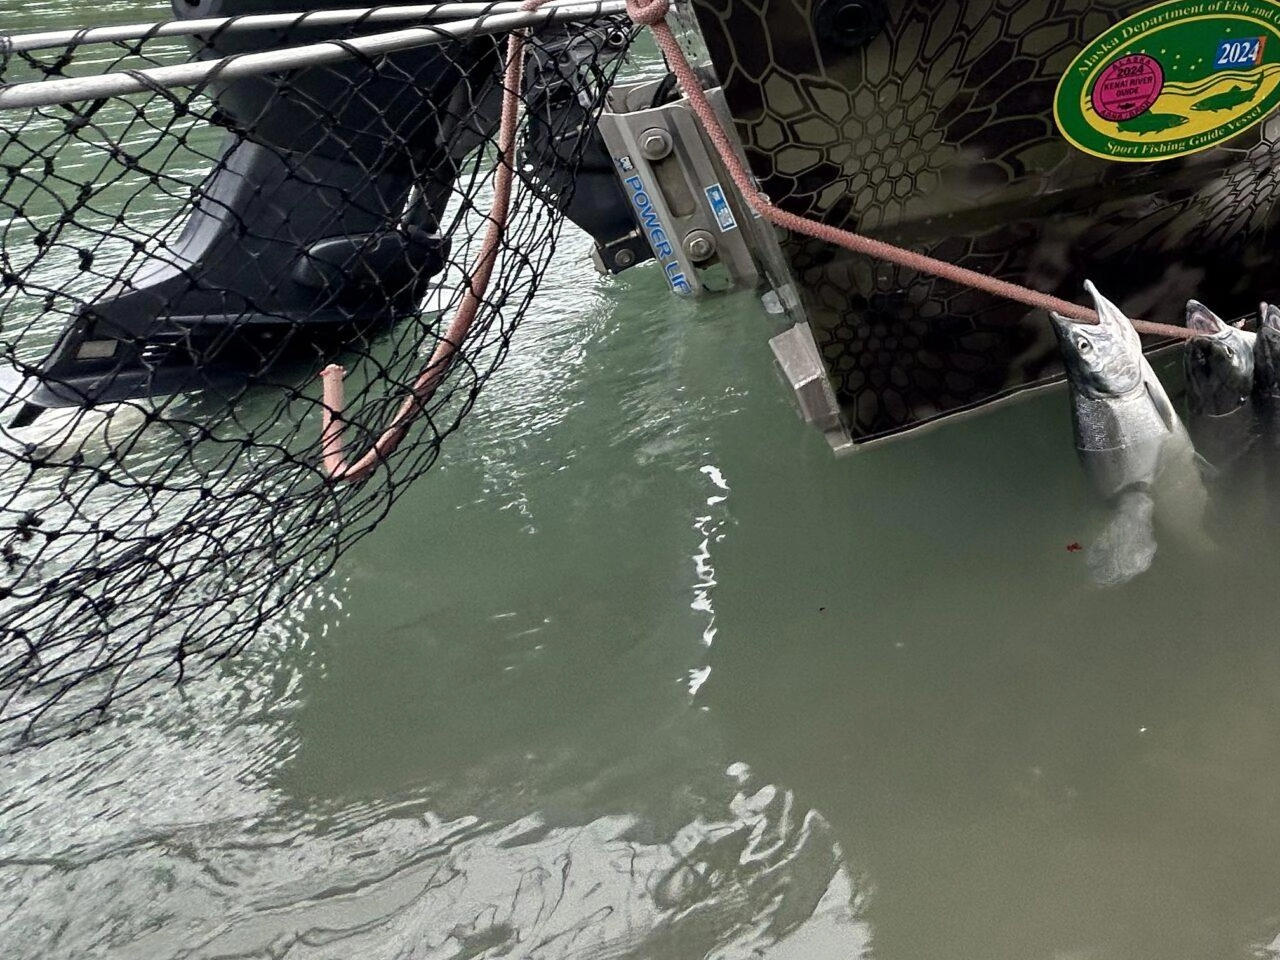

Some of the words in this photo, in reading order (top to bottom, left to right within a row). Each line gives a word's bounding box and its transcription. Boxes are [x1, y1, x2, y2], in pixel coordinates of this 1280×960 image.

[1078, 37, 1119, 75] Alaska
[1122, 4, 1203, 38] Department
[1207, 1, 1222, 13] of
[1224, 0, 1250, 14] Fish
[1251, 5, 1275, 20] and
[1217, 41, 1260, 65] 2024
[1103, 80, 1129, 91] KENAI
[1129, 76, 1154, 87] RIVER
[1117, 65, 1145, 78] 2024
[1105, 141, 1140, 154] Sport
[1141, 140, 1187, 155] Fishing
[1189, 126, 1226, 148] Guide
[1226, 106, 1264, 132] Vessel
[625, 175, 672, 258] POWER
[665, 261, 692, 295] LIF
